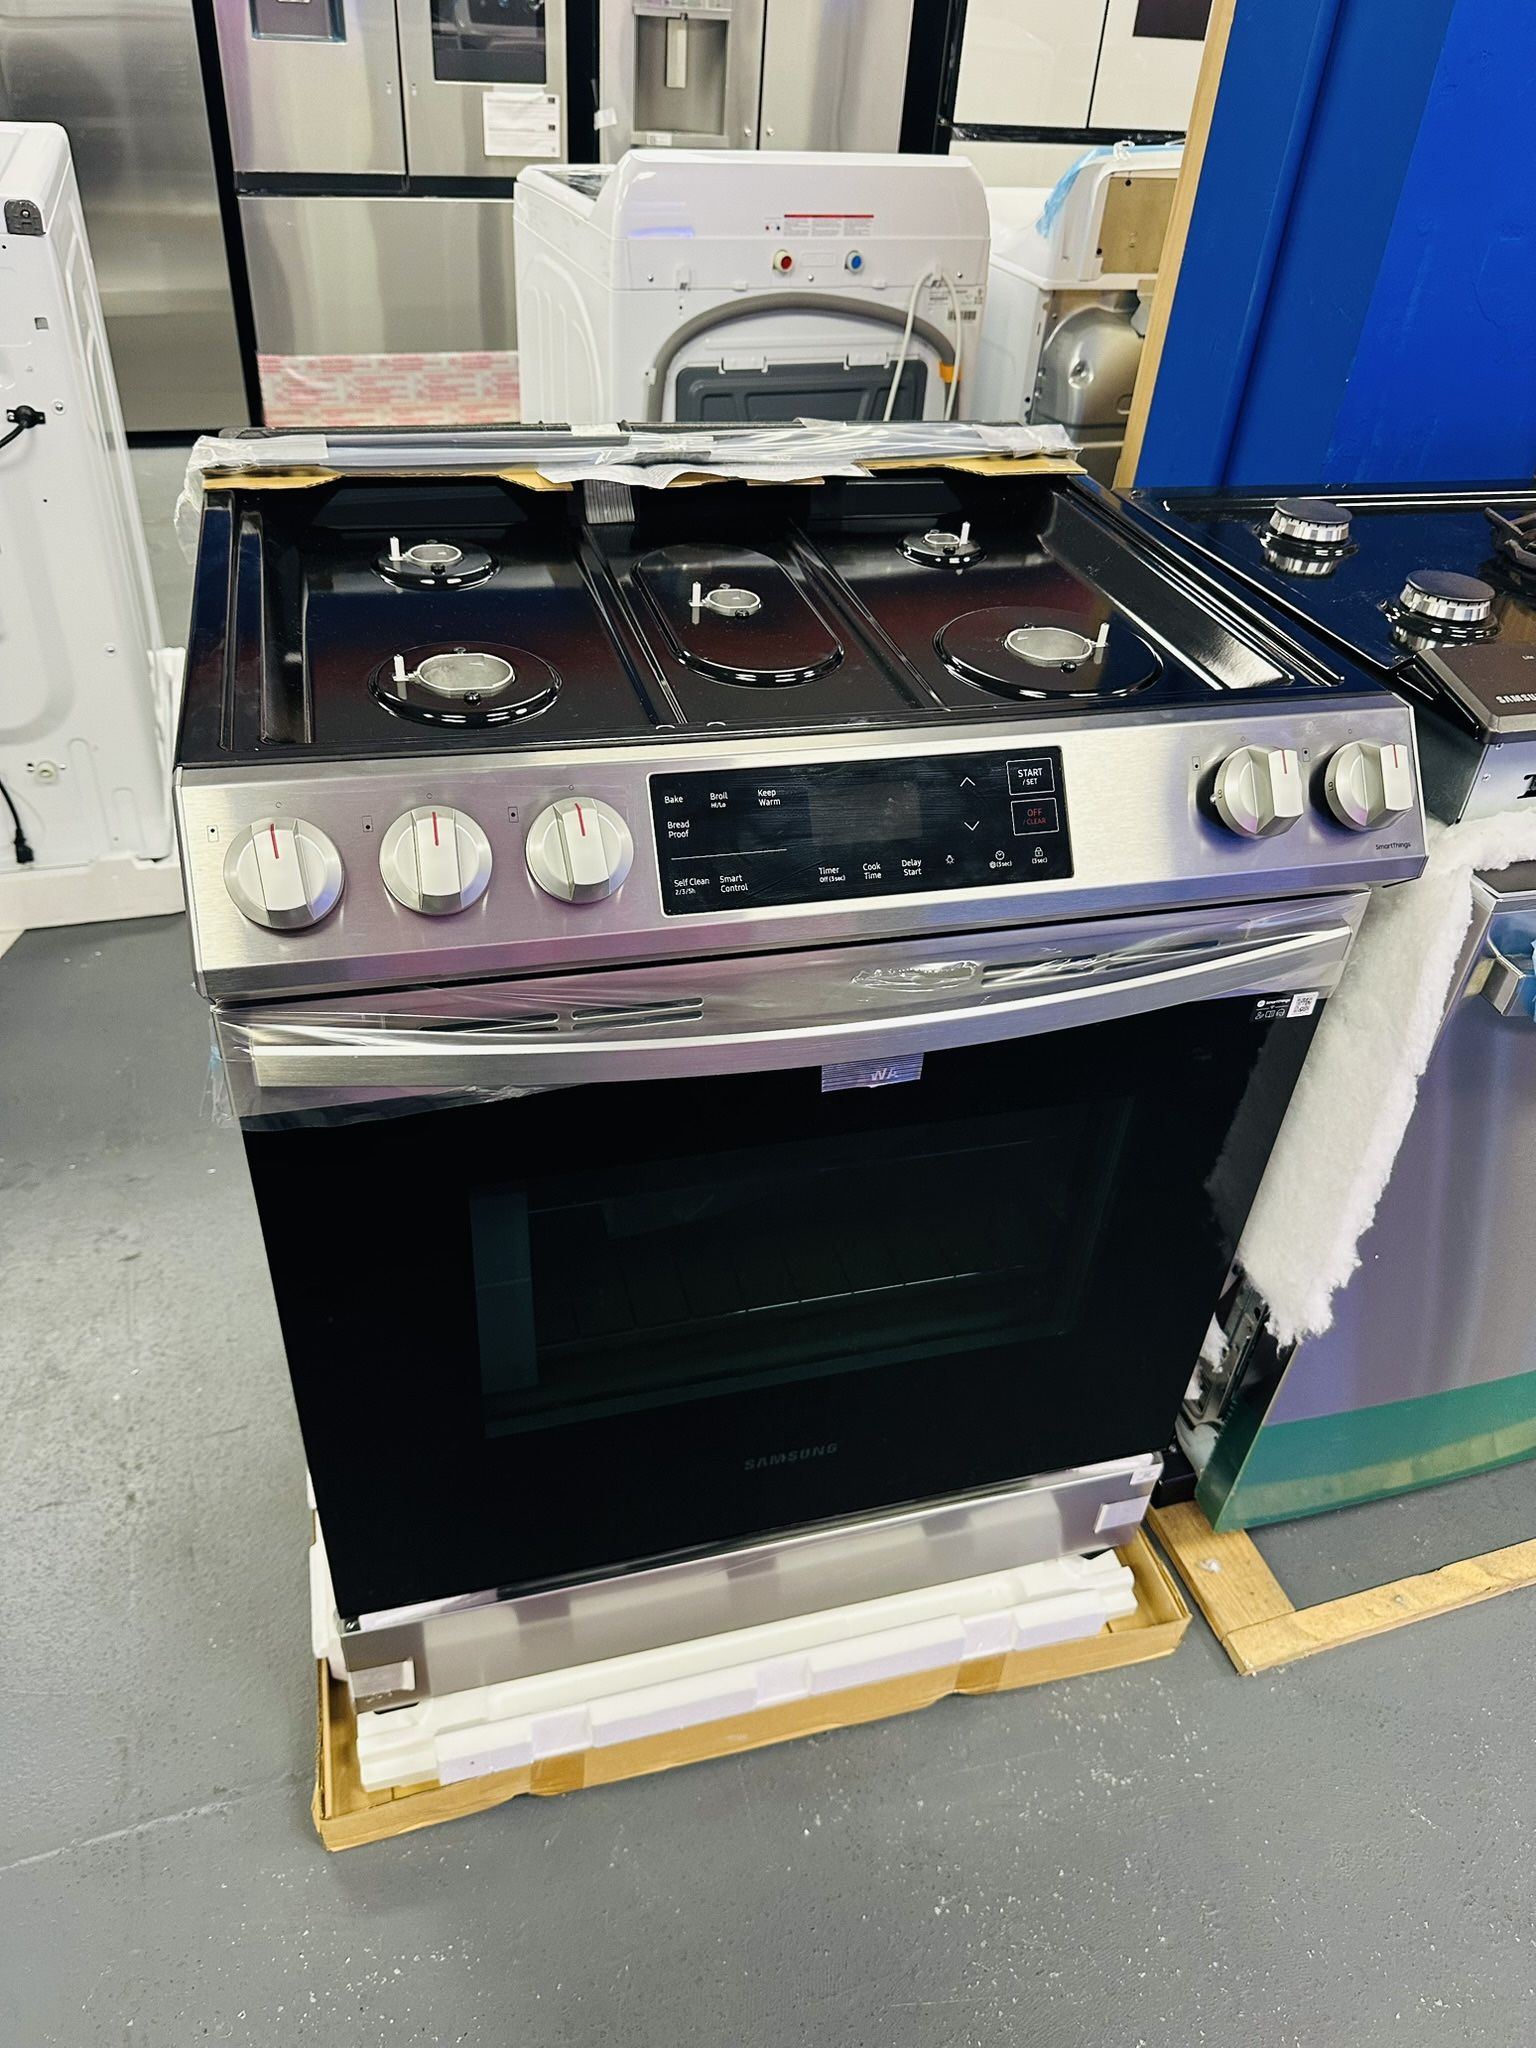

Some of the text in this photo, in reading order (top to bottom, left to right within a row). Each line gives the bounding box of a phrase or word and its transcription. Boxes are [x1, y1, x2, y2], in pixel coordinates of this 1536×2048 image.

[1496, 693, 1536, 703] SAMSU
[1017, 768, 1043, 777] START
[709, 792, 728, 800] Broil
[757, 789, 777, 797] Keep
[664, 795, 683, 804] Bake
[758, 798, 781, 807] Warm
[1027, 808, 1042, 817] OFF
[667, 820, 690, 829] Bread
[668, 829, 689, 838] Proof
[1375, 842, 1411, 850] SmartThings
[862, 862, 881, 871] Cook
[901, 858, 922, 868] Delay
[818, 867, 839, 875] Timer
[863, 871, 882, 880] Time
[903, 868, 922, 877] Start
[673, 877, 711, 888] Self Clean
[719, 874, 743, 884] Smart
[720, 882, 749, 893] Control
[744, 1442, 838, 1471] SAMSUNG
